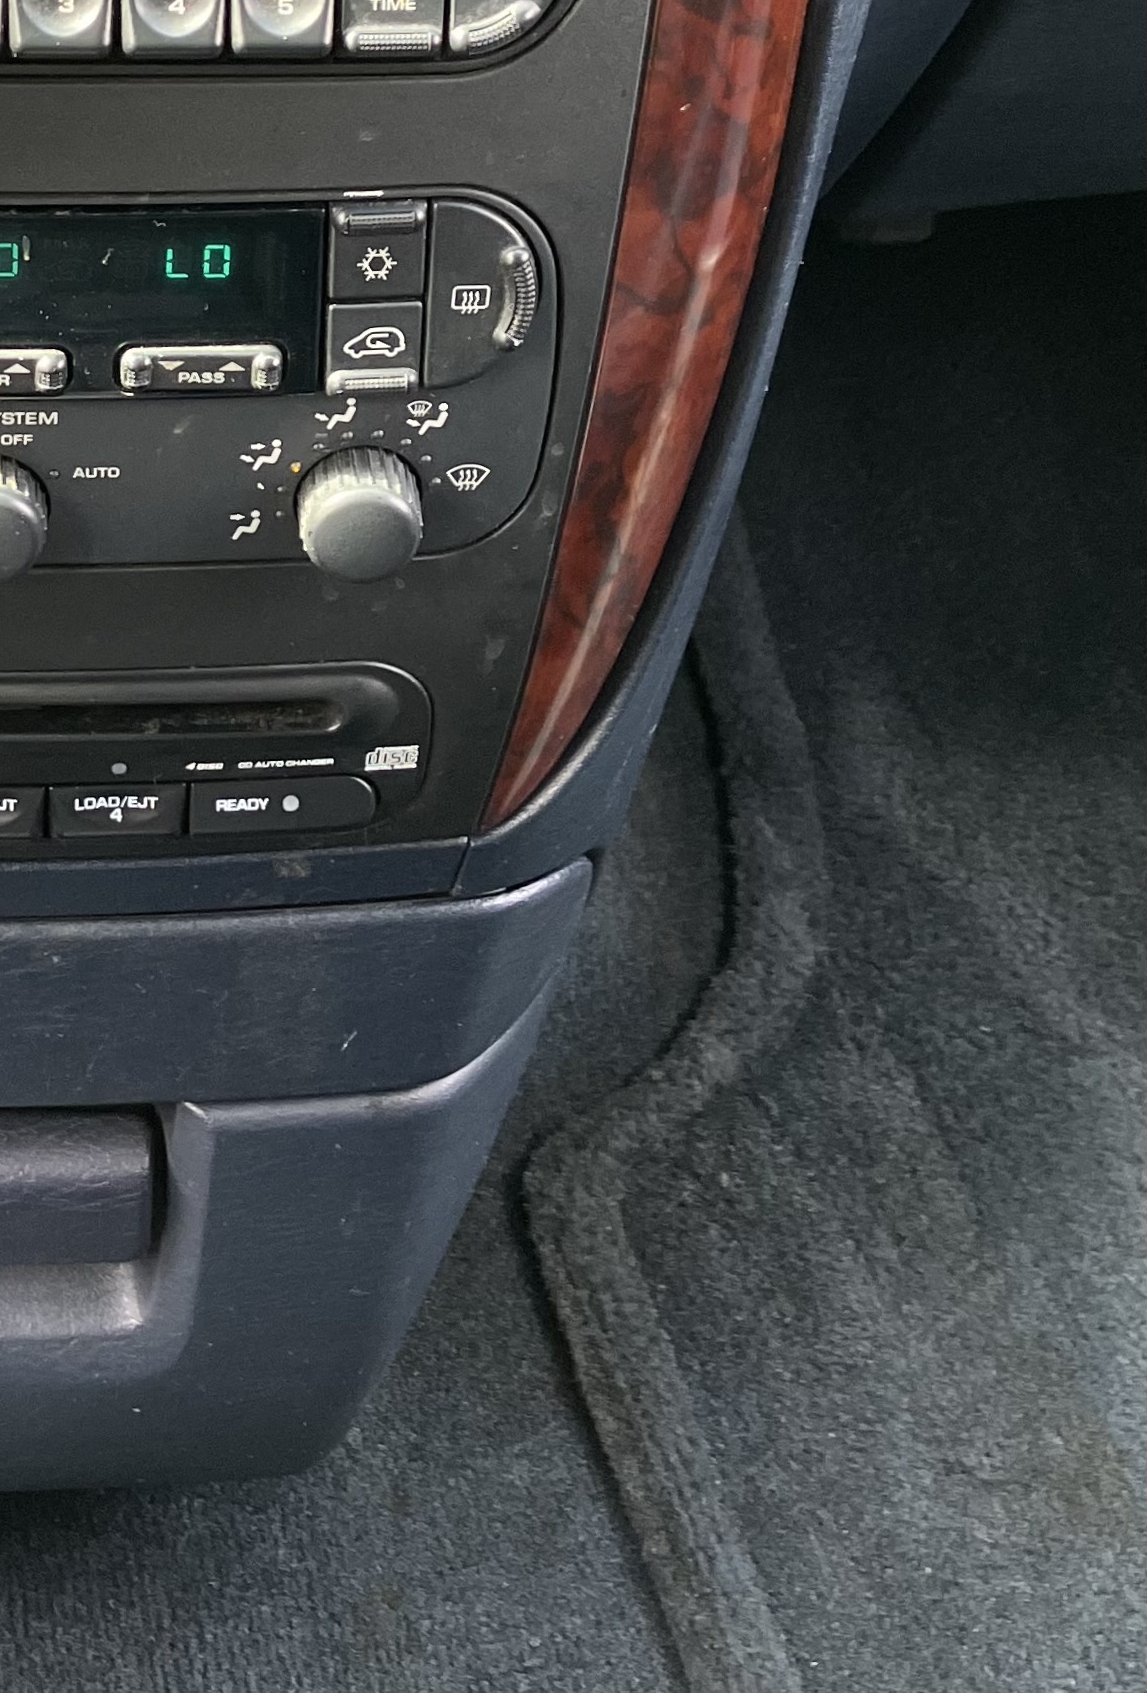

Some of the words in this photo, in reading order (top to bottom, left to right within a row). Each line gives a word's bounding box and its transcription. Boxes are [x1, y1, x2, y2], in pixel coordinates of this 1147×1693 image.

[177, 370, 226, 385] PASS
[0, 433, 34, 446] OFF
[72, 466, 121, 479] AUTO
[253, 759, 284, 769] AUTO
[284, 757, 335, 768] CHANGER
[73, 795, 159, 812] LOAD/EJT
[215, 797, 270, 812] READY
[108, 807, 124, 823] 4
